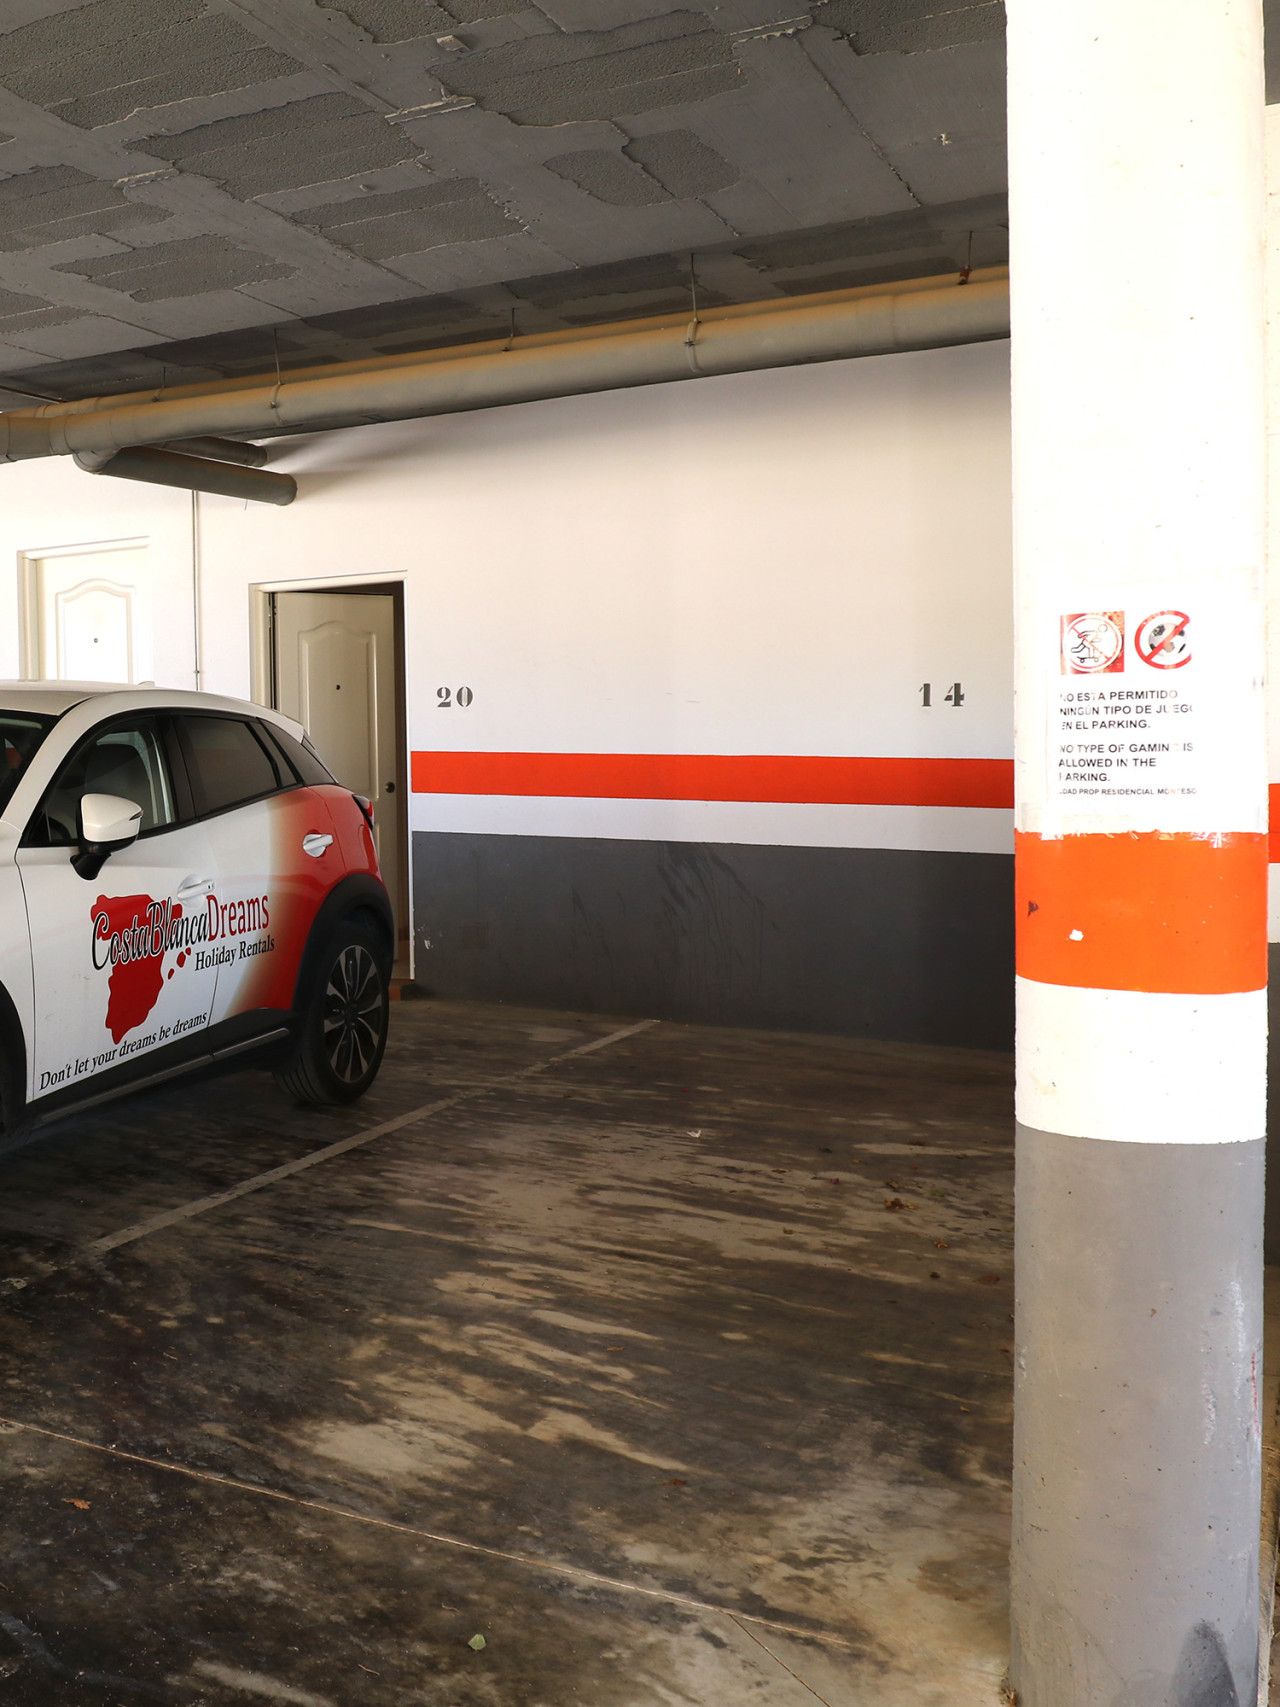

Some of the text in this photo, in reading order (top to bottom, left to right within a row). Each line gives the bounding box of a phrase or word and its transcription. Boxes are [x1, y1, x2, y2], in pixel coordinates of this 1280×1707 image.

[436, 686, 474, 708] 20
[919, 682, 965, 708] 14
[1109, 690, 1178, 701] PERMITIDO
[1104, 705, 1132, 715] TIPO
[1135, 705, 1152, 714] DE
[1075, 721, 1089, 730] EL
[1091, 719, 1151, 730] PARKING.
[1077, 744, 1105, 753] TYPE
[1108, 744, 1125, 753] OF
[1128, 743, 1179, 753] GAMIN
[1182, 742, 1194, 752] IS
[1058, 757, 1157, 768] ALLOWED IN THE
[194, 936, 276, 972] Holiday Rentals
[39, 1010, 207, 1092] Don't let your dreams be dreams
